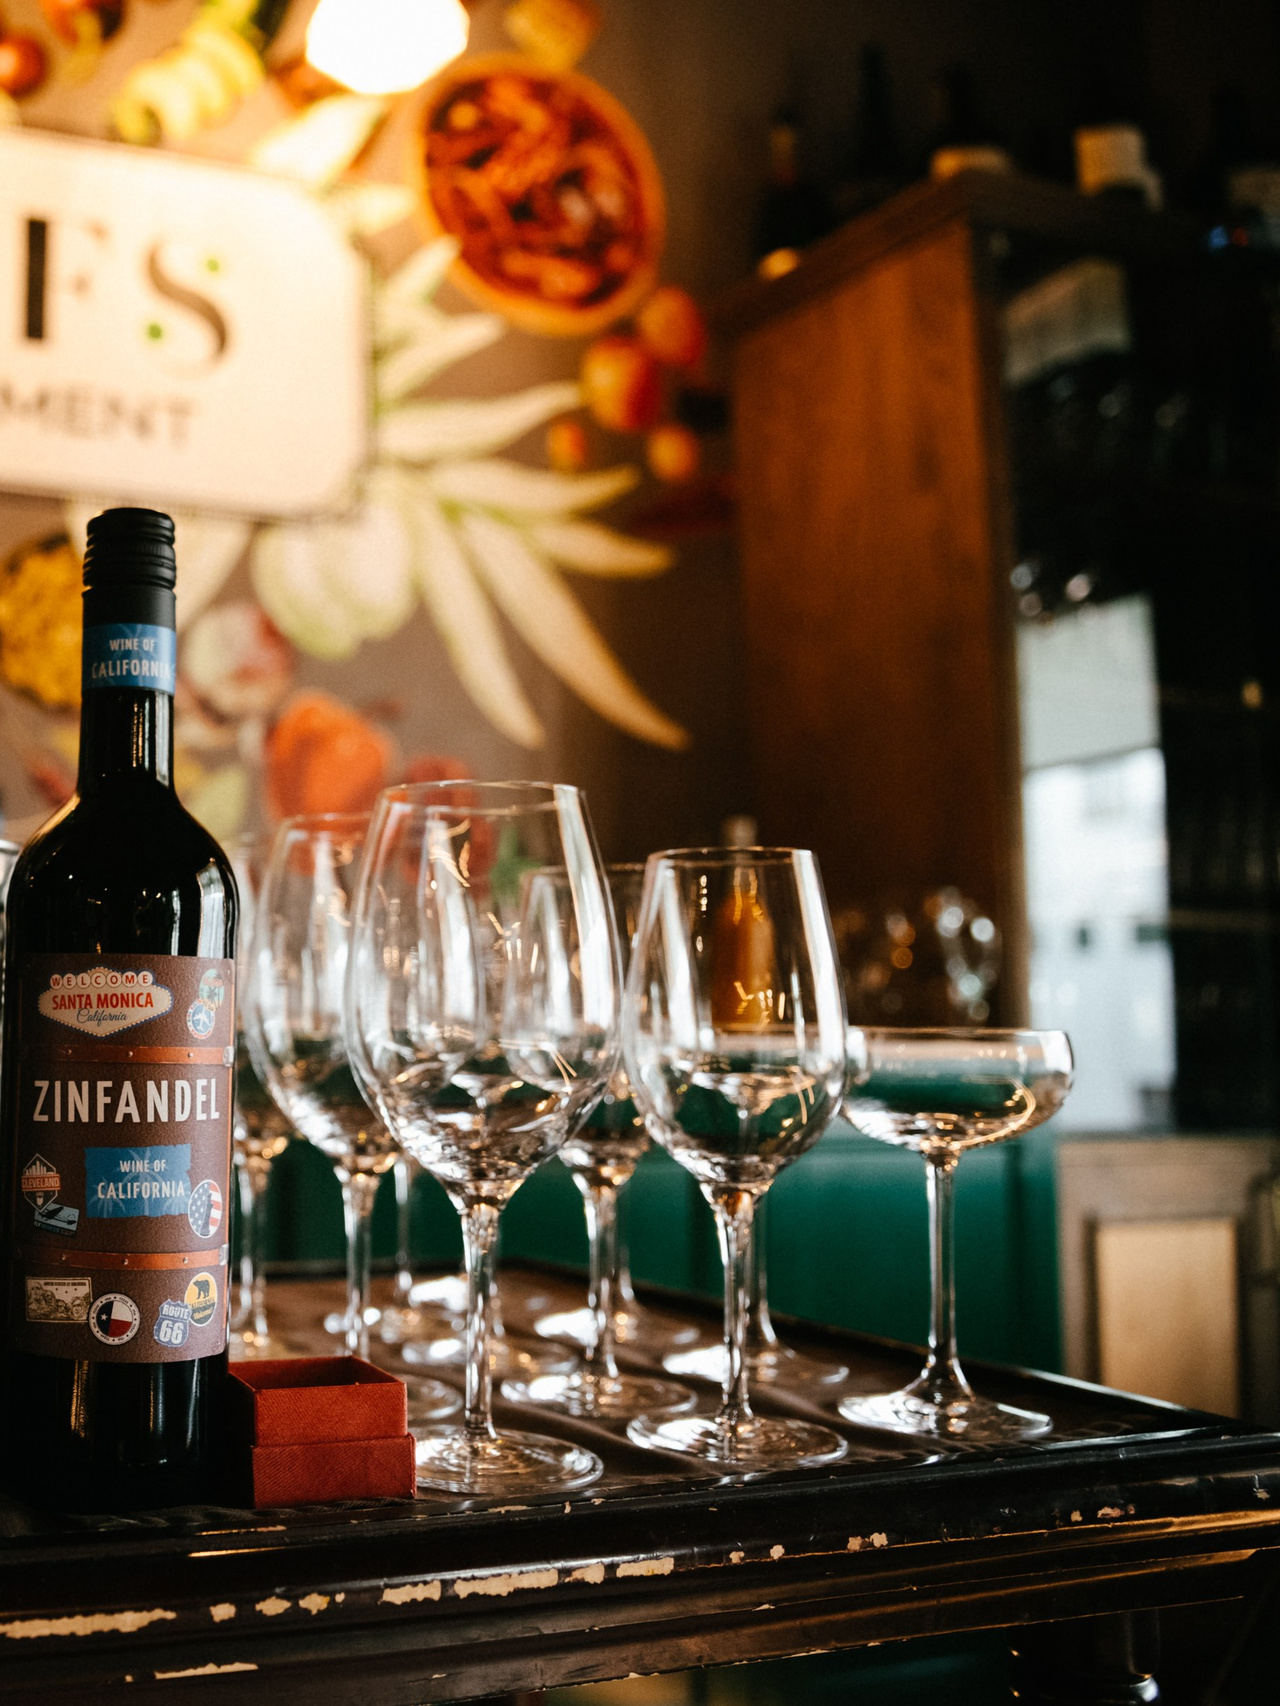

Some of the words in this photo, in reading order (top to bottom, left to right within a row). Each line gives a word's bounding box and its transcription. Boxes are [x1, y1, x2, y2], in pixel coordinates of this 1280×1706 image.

[109, 638, 139, 651] WINE
[142, 638, 156, 651] OF
[51, 974, 149, 987] WELCOME
[52, 993, 93, 1011] SANTA
[96, 992, 154, 1009] MONICA
[76, 1007, 128, 1027] California
[32, 1077, 220, 1124] ZINFANDEL
[119, 1159, 150, 1173] WINE
[153, 1159, 167, 1172] OF
[22, 1177, 60, 1189] CLEVELAND
[97, 1180, 186, 1200] CALIFORNIA
[162, 1304, 190, 1320] ROUTE
[159, 1319, 185, 1345] 66
